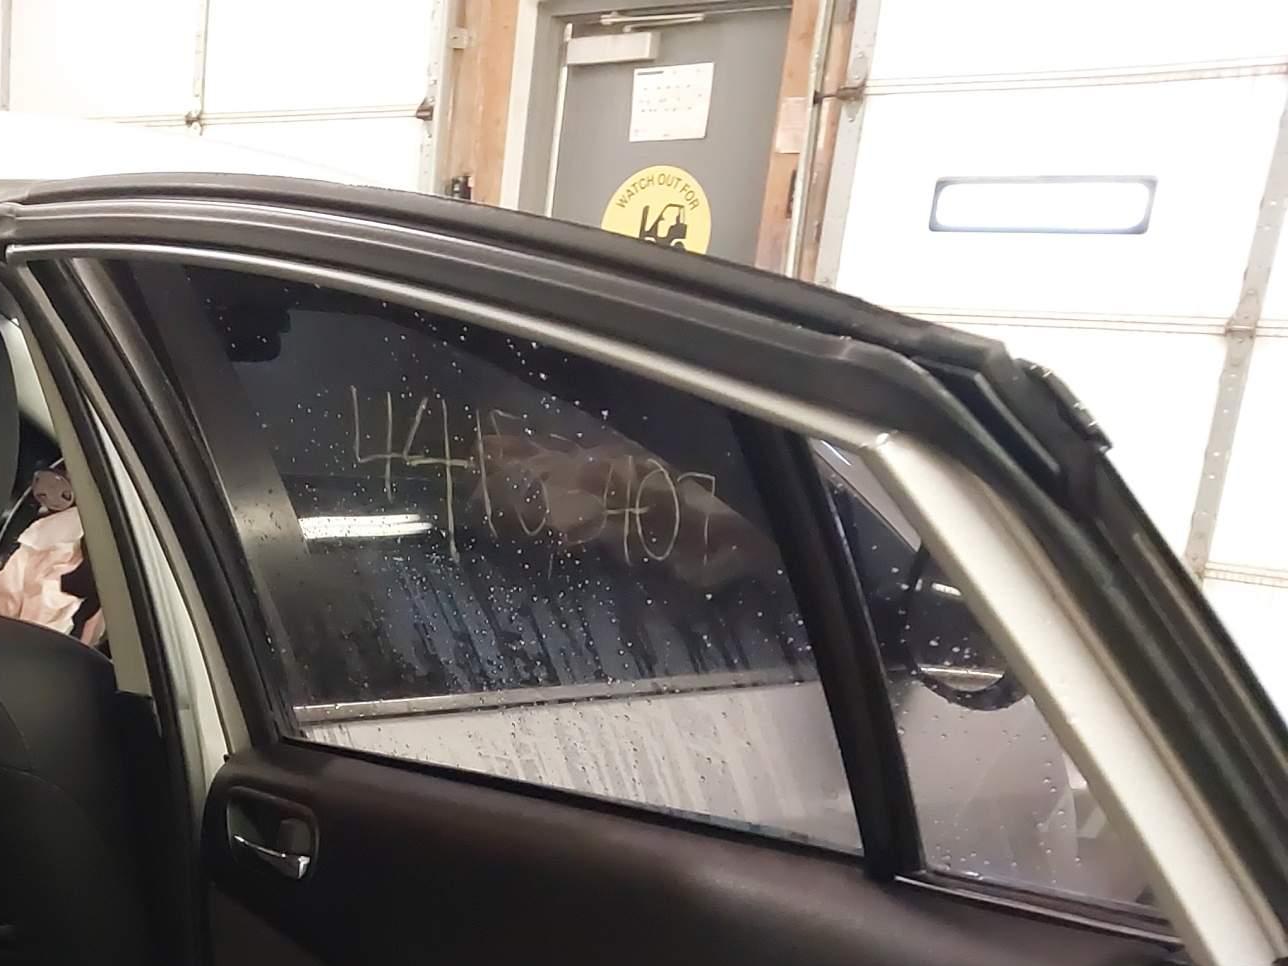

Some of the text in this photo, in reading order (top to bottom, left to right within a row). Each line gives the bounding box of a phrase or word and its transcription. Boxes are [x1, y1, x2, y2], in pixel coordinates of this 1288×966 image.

[616, 173, 700, 210] WATCH OUT FOR
